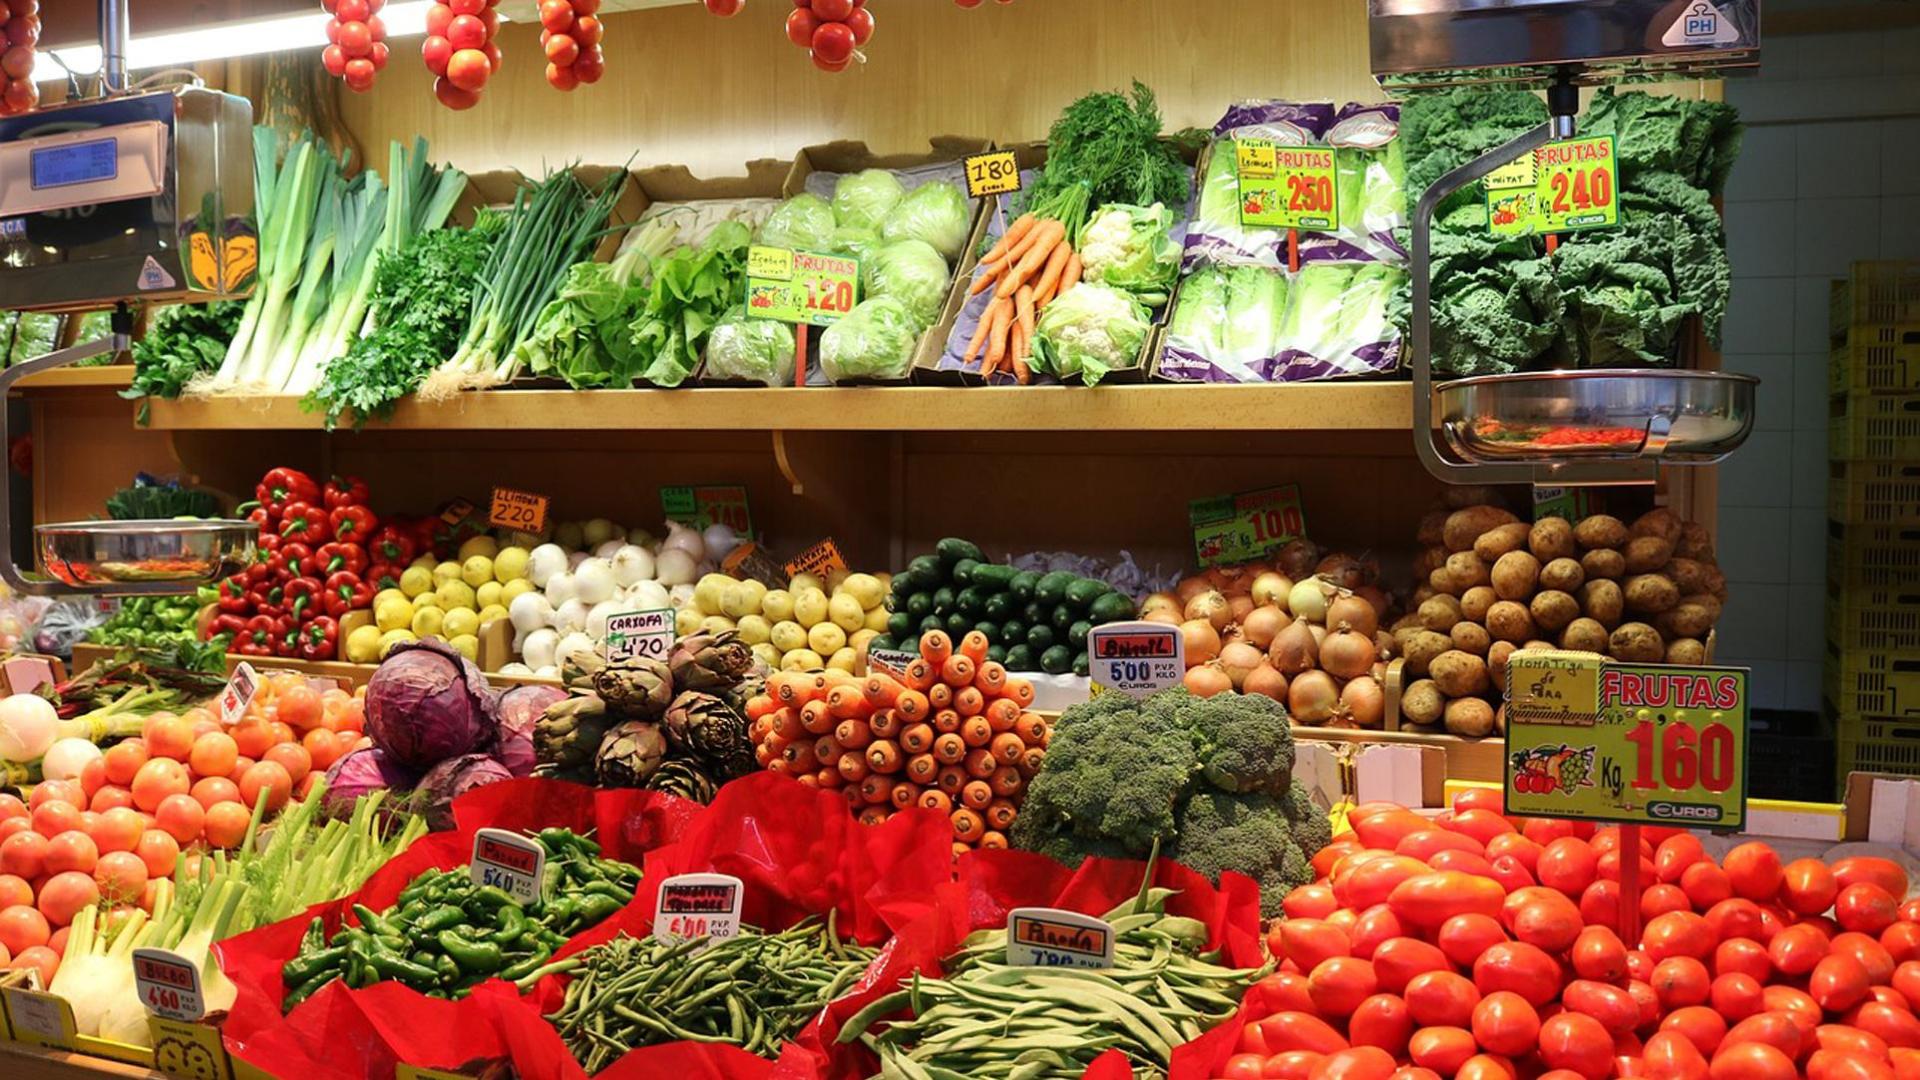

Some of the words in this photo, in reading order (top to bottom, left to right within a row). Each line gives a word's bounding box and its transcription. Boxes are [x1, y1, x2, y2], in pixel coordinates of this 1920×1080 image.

[1688, 20, 1712, 32] PH
[1277, 151, 1332, 169] FRUTAS
[1536, 140, 1609, 167] FRUTAS
[972, 159, 1014, 182] 1'80
[794, 254, 856, 276] FRUTAS
[494, 503, 535, 523] 2'20
[610, 614, 662, 631] CARXOFA
[1154, 663, 1176, 671] P.V.P.
[1155, 671, 1176, 679] KILO
[1604, 671, 1738, 710] FRUTAS
[1653, 803, 1720, 818] EUROS
[711, 929, 730, 938] KILO
[147, 985, 180, 1011] 4'60
